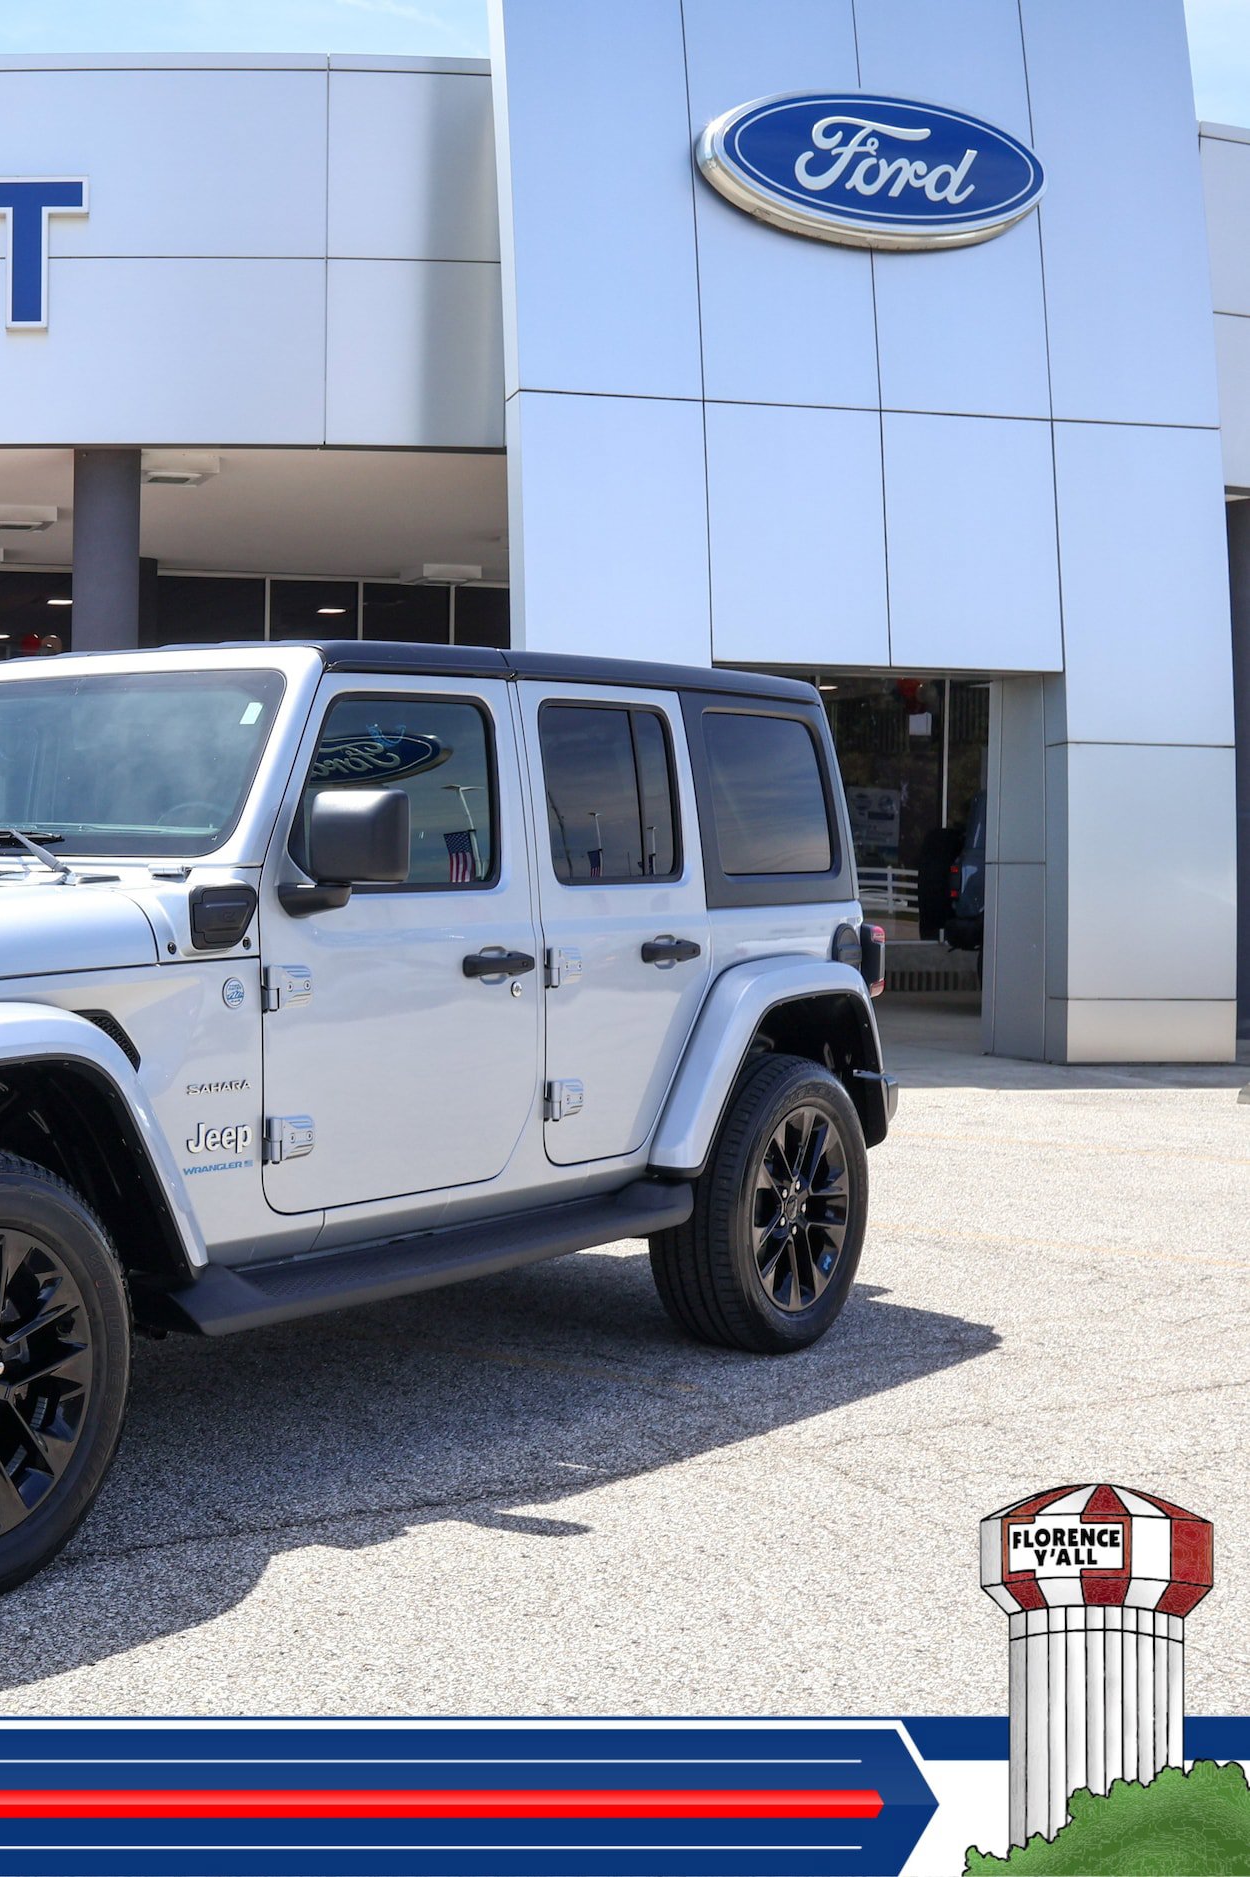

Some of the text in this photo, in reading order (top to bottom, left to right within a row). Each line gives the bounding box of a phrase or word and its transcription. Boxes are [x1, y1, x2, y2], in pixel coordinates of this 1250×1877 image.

[794, 116, 978, 204] Ford
[187, 1079, 251, 1095] SAHARA
[187, 1122, 252, 1154] Jeep
[183, 1161, 242, 1175] WRANGLER
